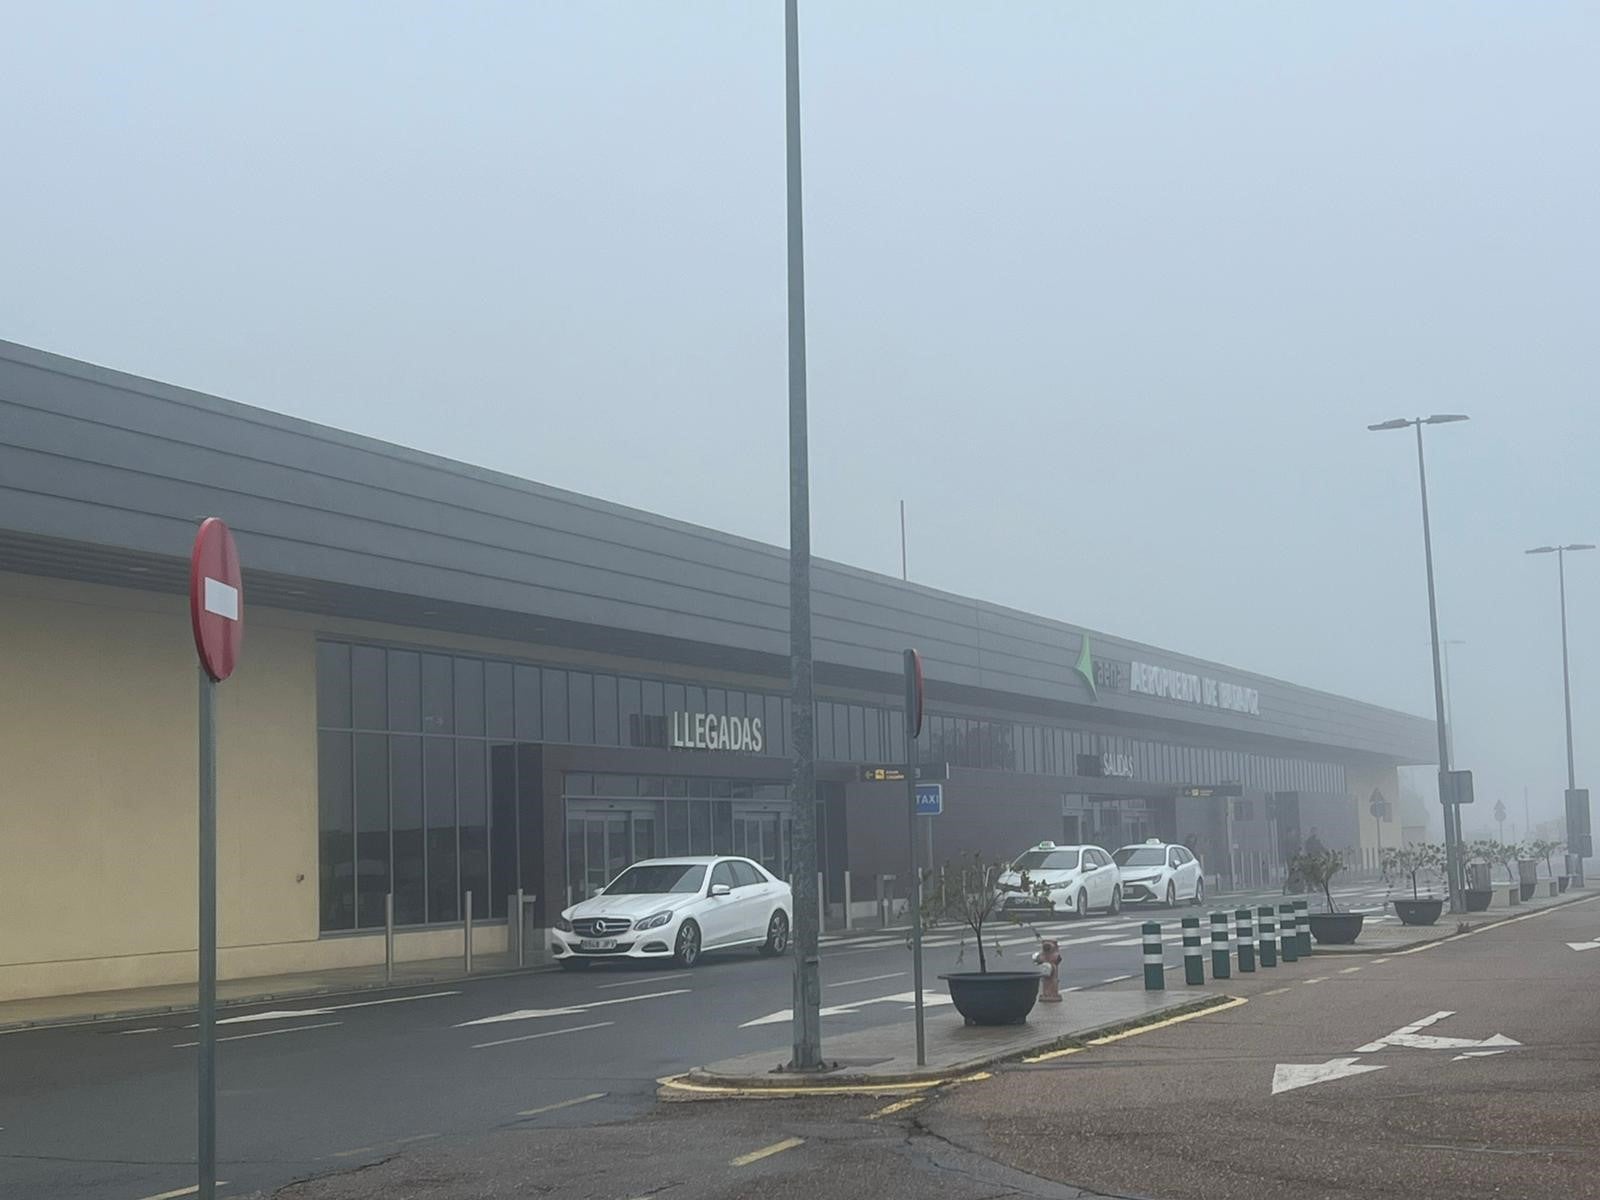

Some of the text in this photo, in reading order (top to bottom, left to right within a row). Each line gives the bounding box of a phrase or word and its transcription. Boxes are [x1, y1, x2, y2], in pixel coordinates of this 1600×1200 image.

[1130, 660, 1260, 716] AEROPUERTO DE ADAZ
[674, 711, 763, 752] LLEGADAS
[1103, 751, 1134, 779] SALIDAS
[915, 795, 939, 804] TAXI
